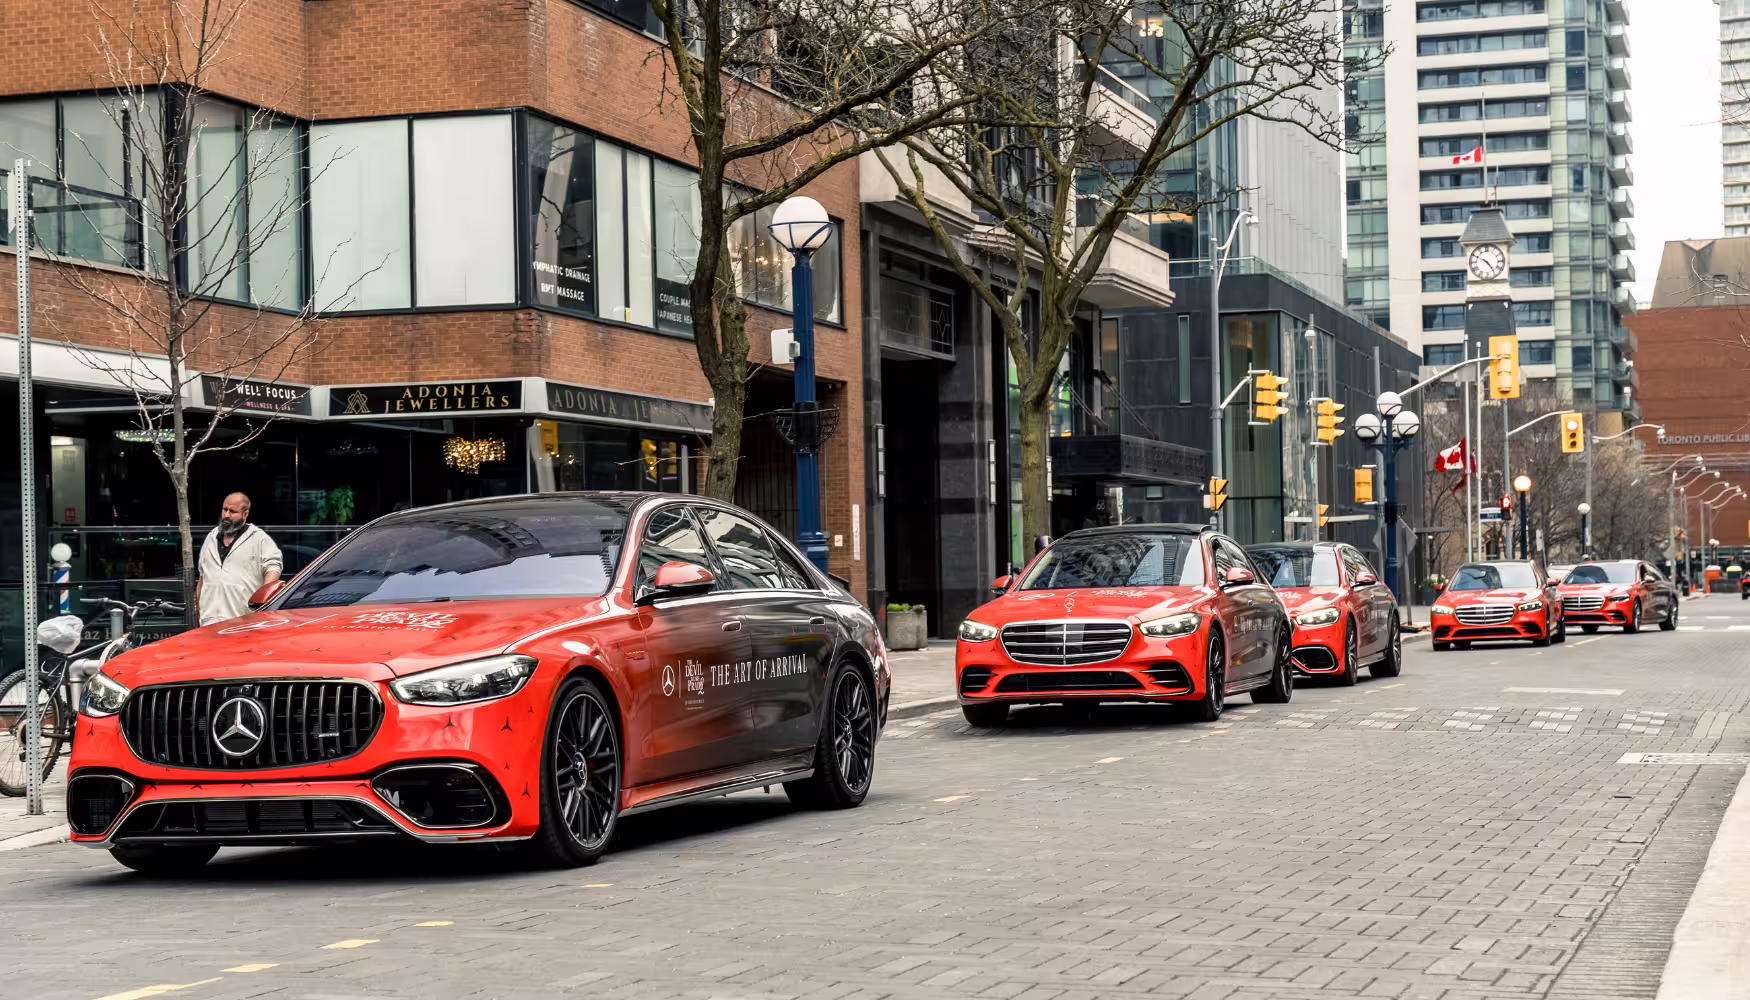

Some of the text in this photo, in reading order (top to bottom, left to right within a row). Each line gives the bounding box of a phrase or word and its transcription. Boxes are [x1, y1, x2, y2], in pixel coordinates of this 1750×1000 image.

[565, 267, 591, 283] DRAINAGE
[541, 282, 585, 302] RMT MASSAGE
[659, 292, 680, 306] COUPLE
[235, 383, 261, 396] WELL
[266, 387, 297, 399] FOCUS
[402, 384, 492, 399] ADONIA
[384, 395, 510, 414] JEWELLERS
[554, 388, 617, 415] ADONIA
[1703, 433, 1735, 443] PUBLIC
[710, 653, 808, 687] THE ART OF ARRIVAL
